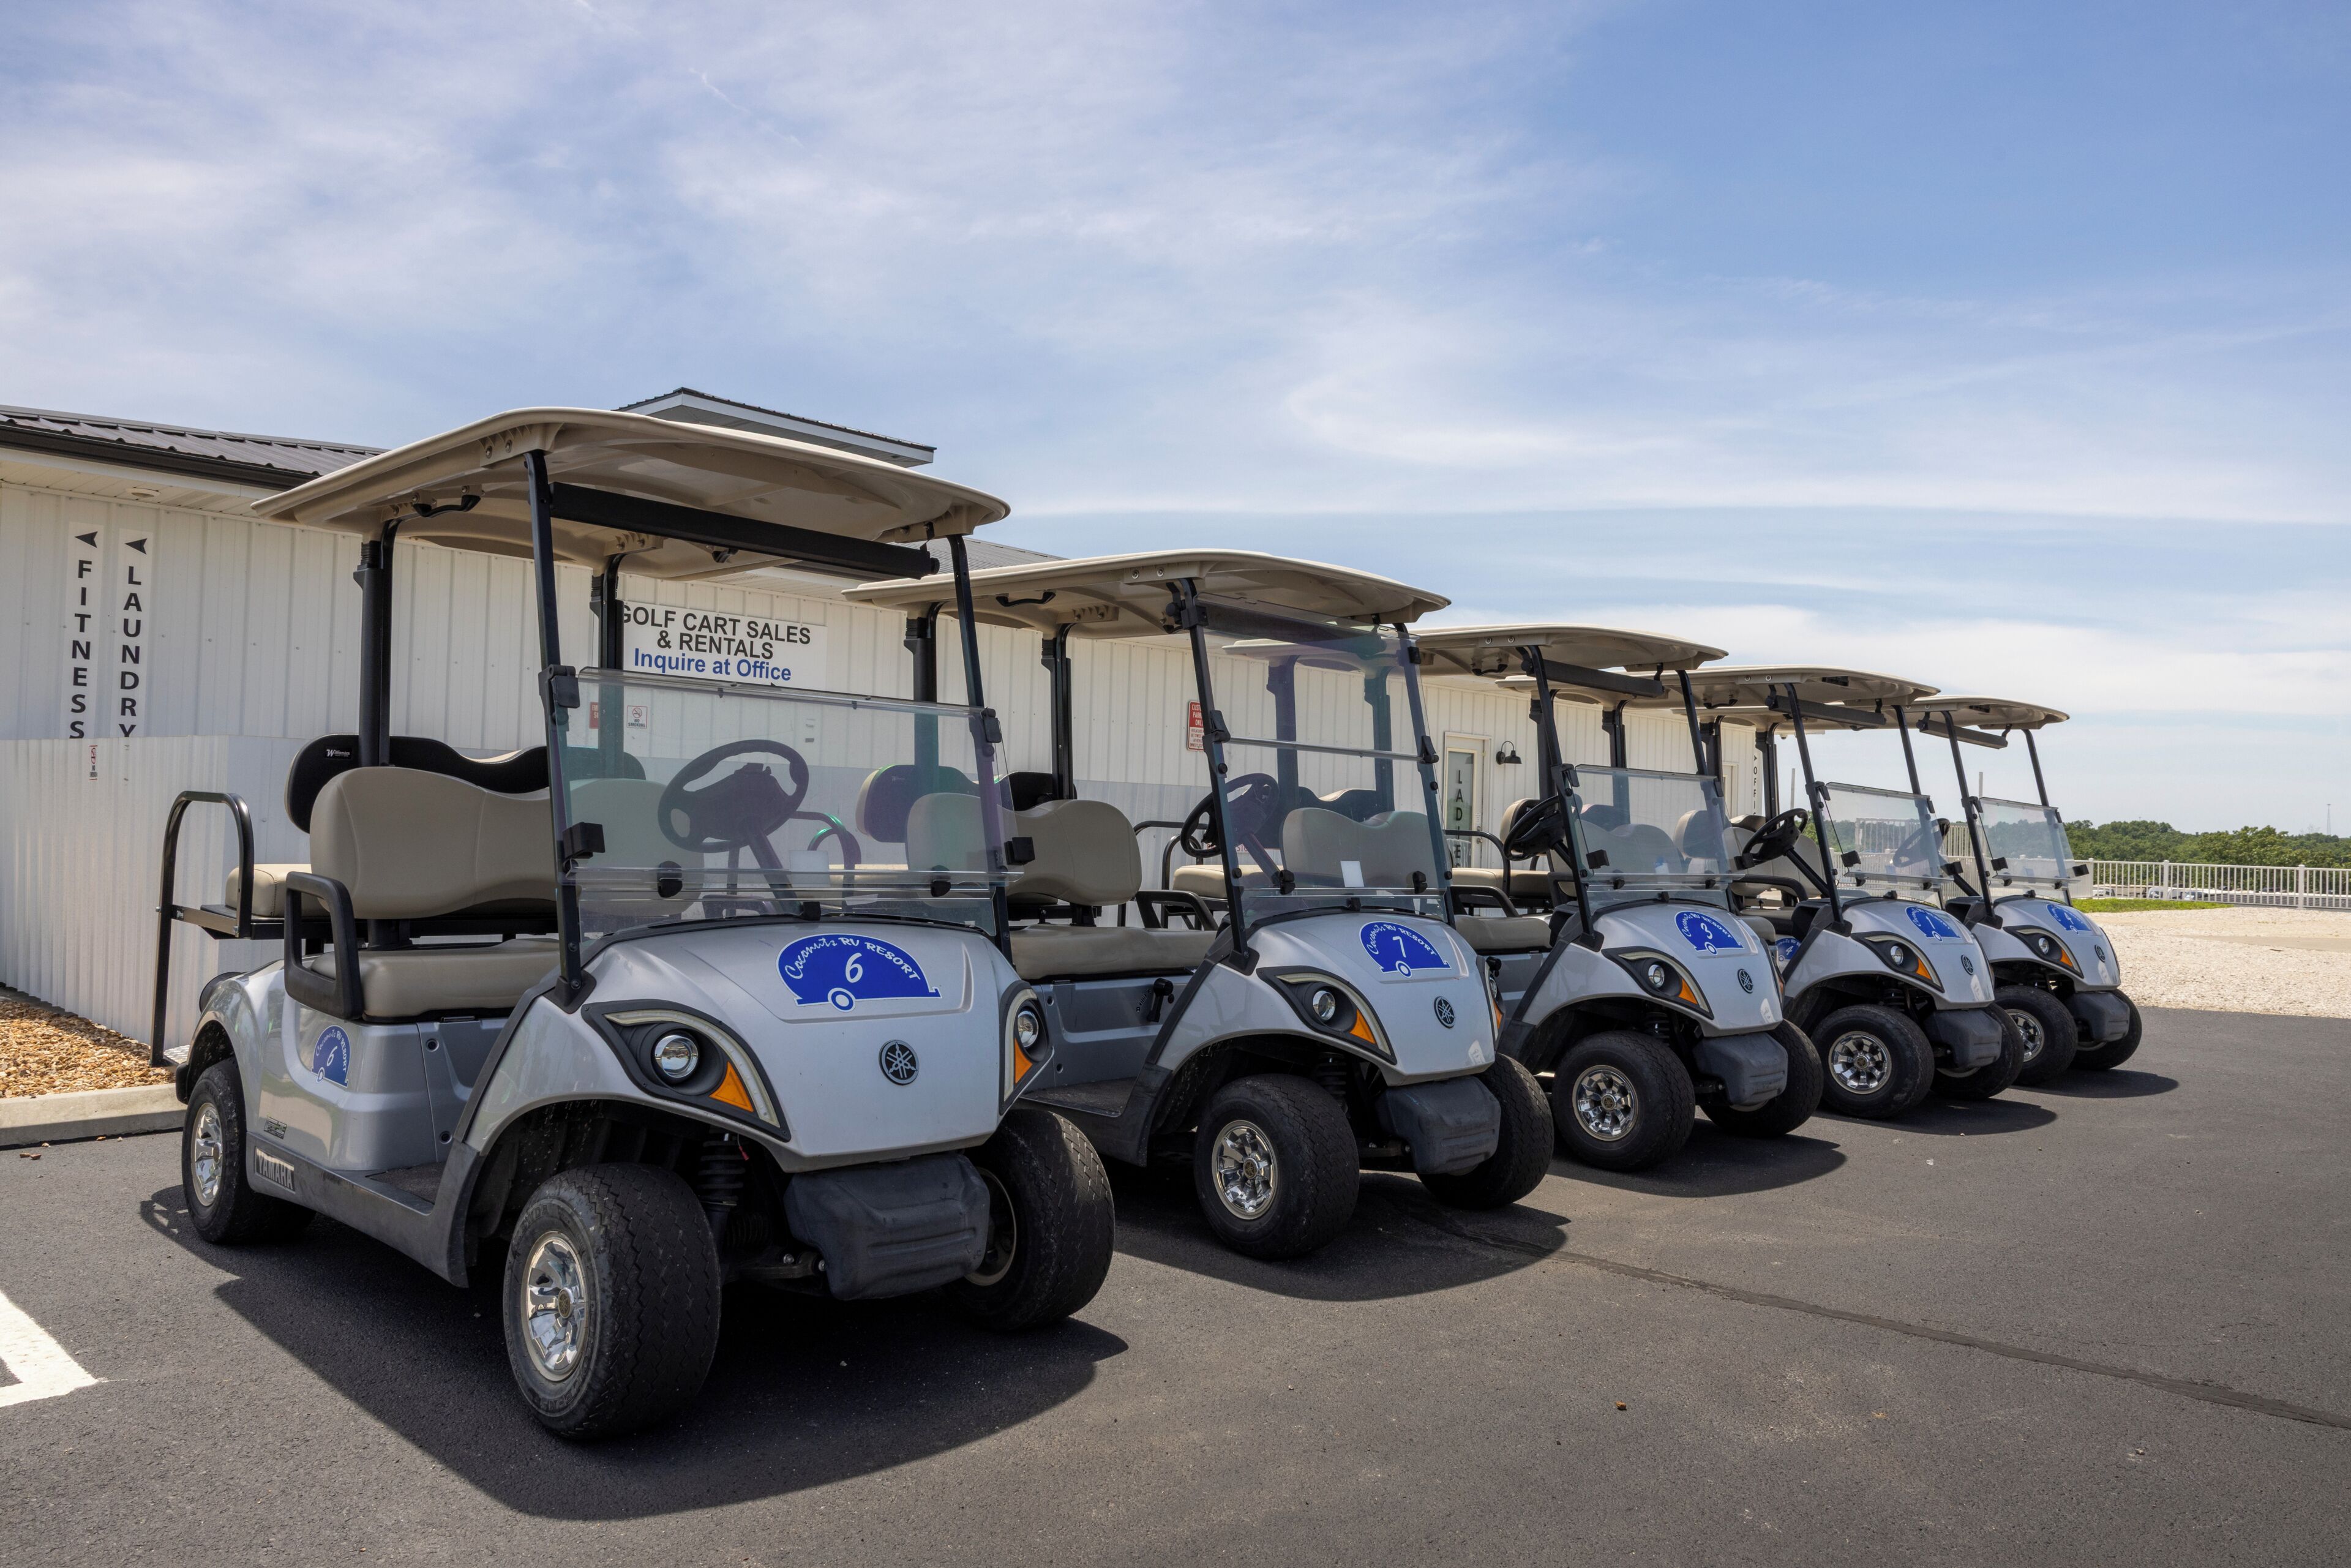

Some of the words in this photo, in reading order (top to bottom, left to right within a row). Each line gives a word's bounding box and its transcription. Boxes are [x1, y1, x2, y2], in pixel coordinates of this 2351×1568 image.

[657, 630, 672, 649] &
[679, 632, 774, 659] RENTALS
[683, 613, 741, 636] CART
[746, 620, 811, 645] SALES
[69, 560, 92, 739] FITNESS
[119, 566, 142, 738] LAUNDRY
[634, 648, 706, 673] Inquire
[713, 658, 730, 675] at
[737, 659, 791, 681] Office
[1398, 928, 1437, 956] RESORT
[1700, 923, 1712, 939] 3
[838, 937, 860, 947] RV
[864, 942, 920, 980] RESORT
[1392, 936, 1406, 958] 7
[1786, 945, 1794, 955] 4
[846, 952, 863, 983] 6
[327, 1046, 338, 1067] 6
[258, 1155, 293, 1190] YAMAHA
